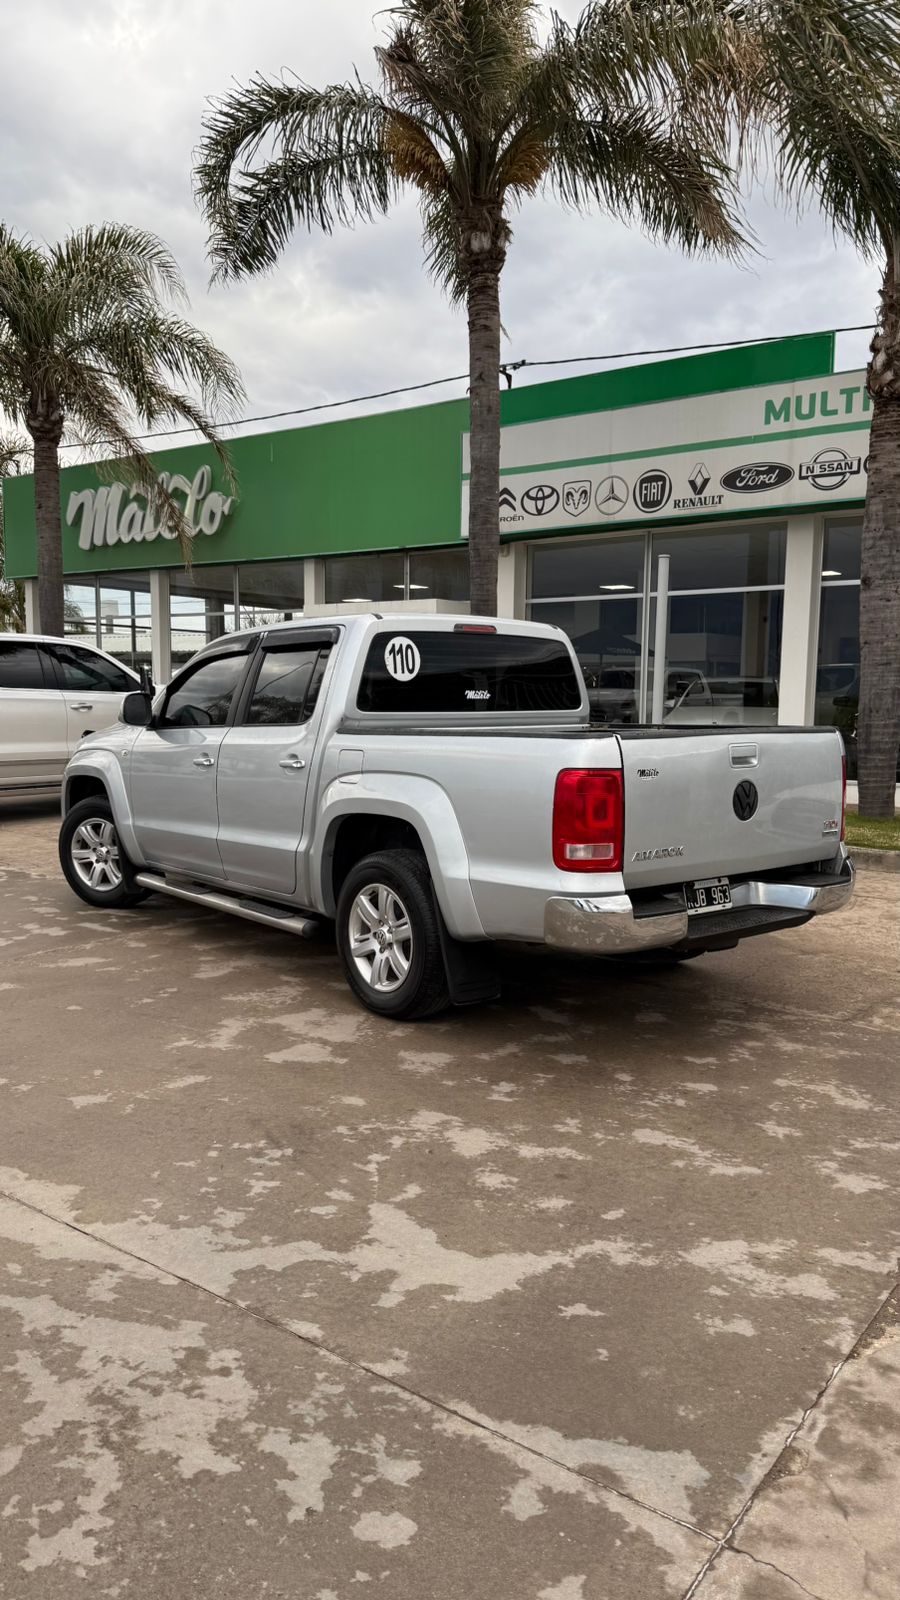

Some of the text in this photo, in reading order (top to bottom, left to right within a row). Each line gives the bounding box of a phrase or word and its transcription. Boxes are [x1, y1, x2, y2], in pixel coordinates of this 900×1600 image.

[736, 466, 779, 487] Ford
[805, 461, 853, 475] NISSAN
[641, 480, 664, 503] FIAT
[673, 494, 724, 510] RENAULT
[388, 643, 415, 675] 110
[711, 885, 731, 905] 963
